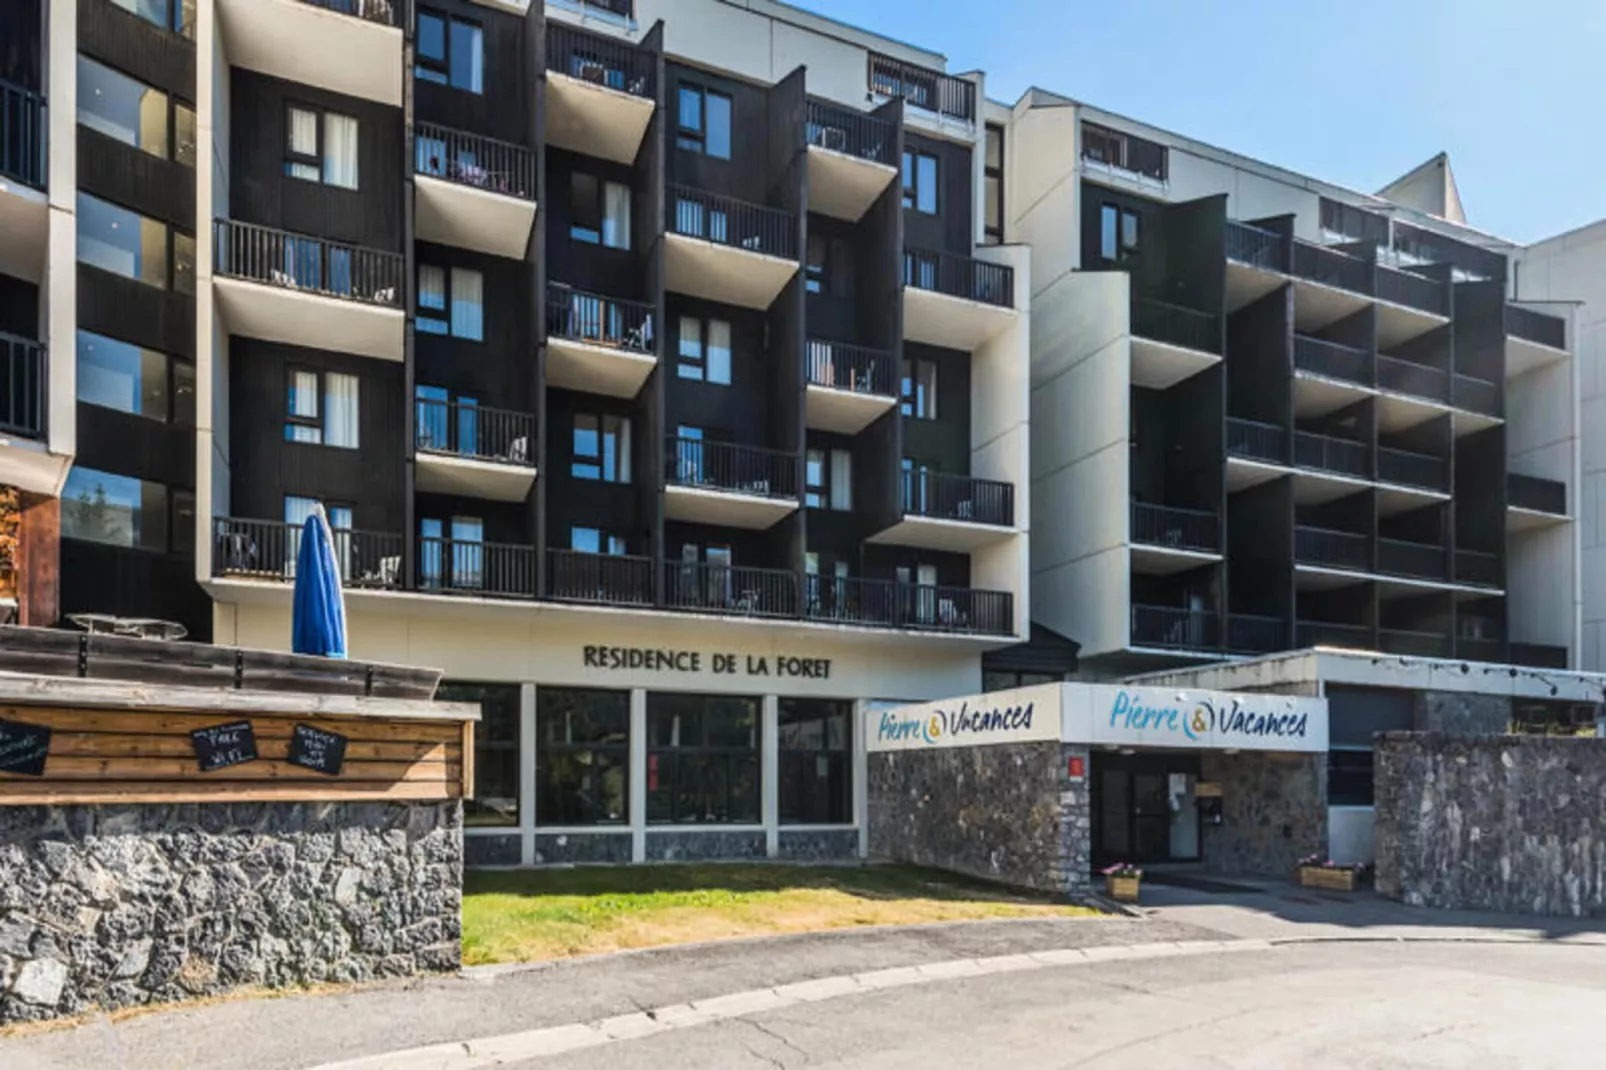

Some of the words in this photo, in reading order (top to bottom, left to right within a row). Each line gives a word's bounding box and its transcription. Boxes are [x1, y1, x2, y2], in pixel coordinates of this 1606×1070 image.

[583, 645, 700, 672] RESIDENCE
[711, 653, 736, 674] DE
[746, 655, 769, 676] LA
[776, 656, 832, 679] FORET
[878, 711, 920, 741] Pierre
[951, 701, 1035, 737] Vacances
[1110, 690, 1179, 730] Pierre
[1219, 699, 1308, 737] Vacances
